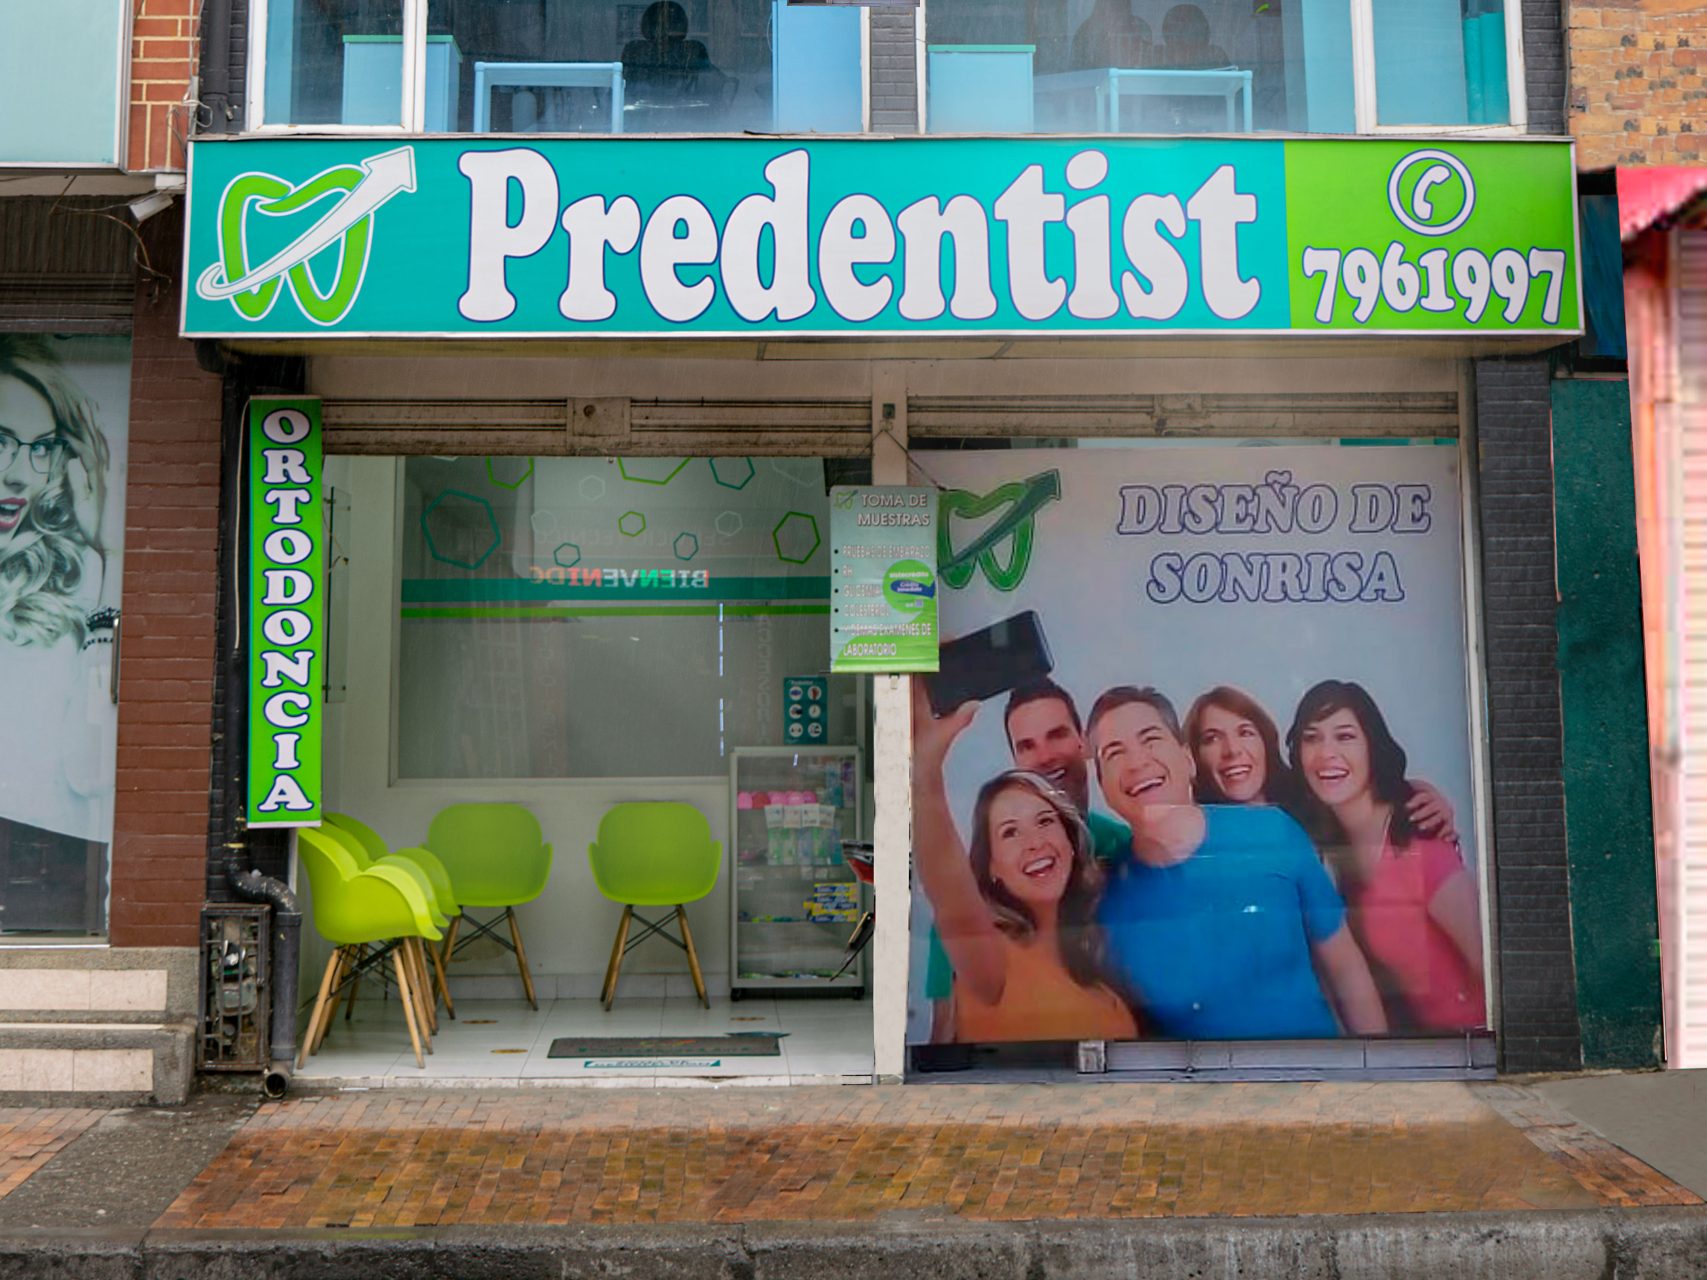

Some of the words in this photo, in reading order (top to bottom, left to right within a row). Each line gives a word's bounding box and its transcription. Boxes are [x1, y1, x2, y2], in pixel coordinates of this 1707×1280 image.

[457, 147, 1261, 324] Predentist
[1301, 240, 1567, 325] 7961997
[857, 513, 931, 526] MUESTRAS
[861, 494, 905, 508] TOMA
[909, 494, 928, 507] DE
[1116, 470, 1338, 535] DISEÑO
[1350, 483, 1432, 534] DE
[1146, 549, 1405, 605] SONRISA
[257, 407, 315, 813] ORTODONCIA
[921, 623, 932, 636] DE
[844, 643, 897, 656] LABORATORIO
